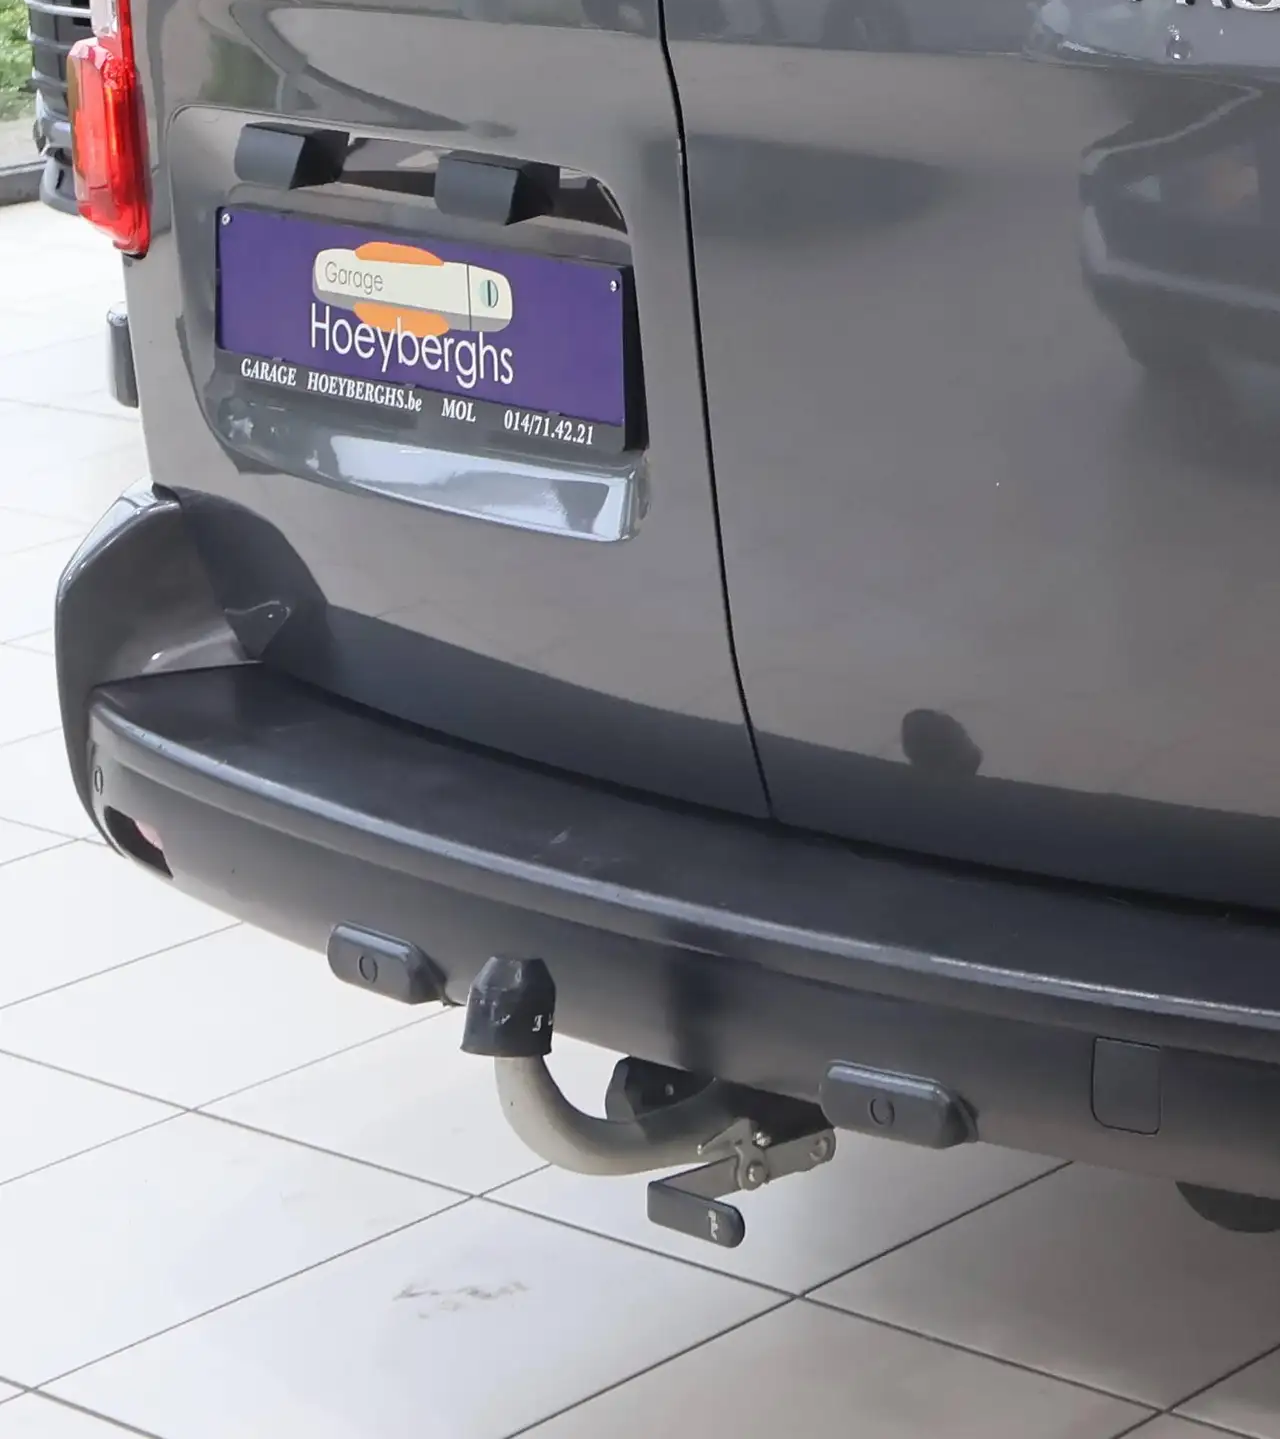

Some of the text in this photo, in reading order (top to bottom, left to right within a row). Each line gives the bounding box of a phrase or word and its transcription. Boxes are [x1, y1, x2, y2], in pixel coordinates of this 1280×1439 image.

[325, 261, 384, 296] Garage
[311, 302, 514, 389] Hoeyberghs
[240, 358, 594, 445] GARAGE HOEYBERGHS.be MOL 014/71.42.21
